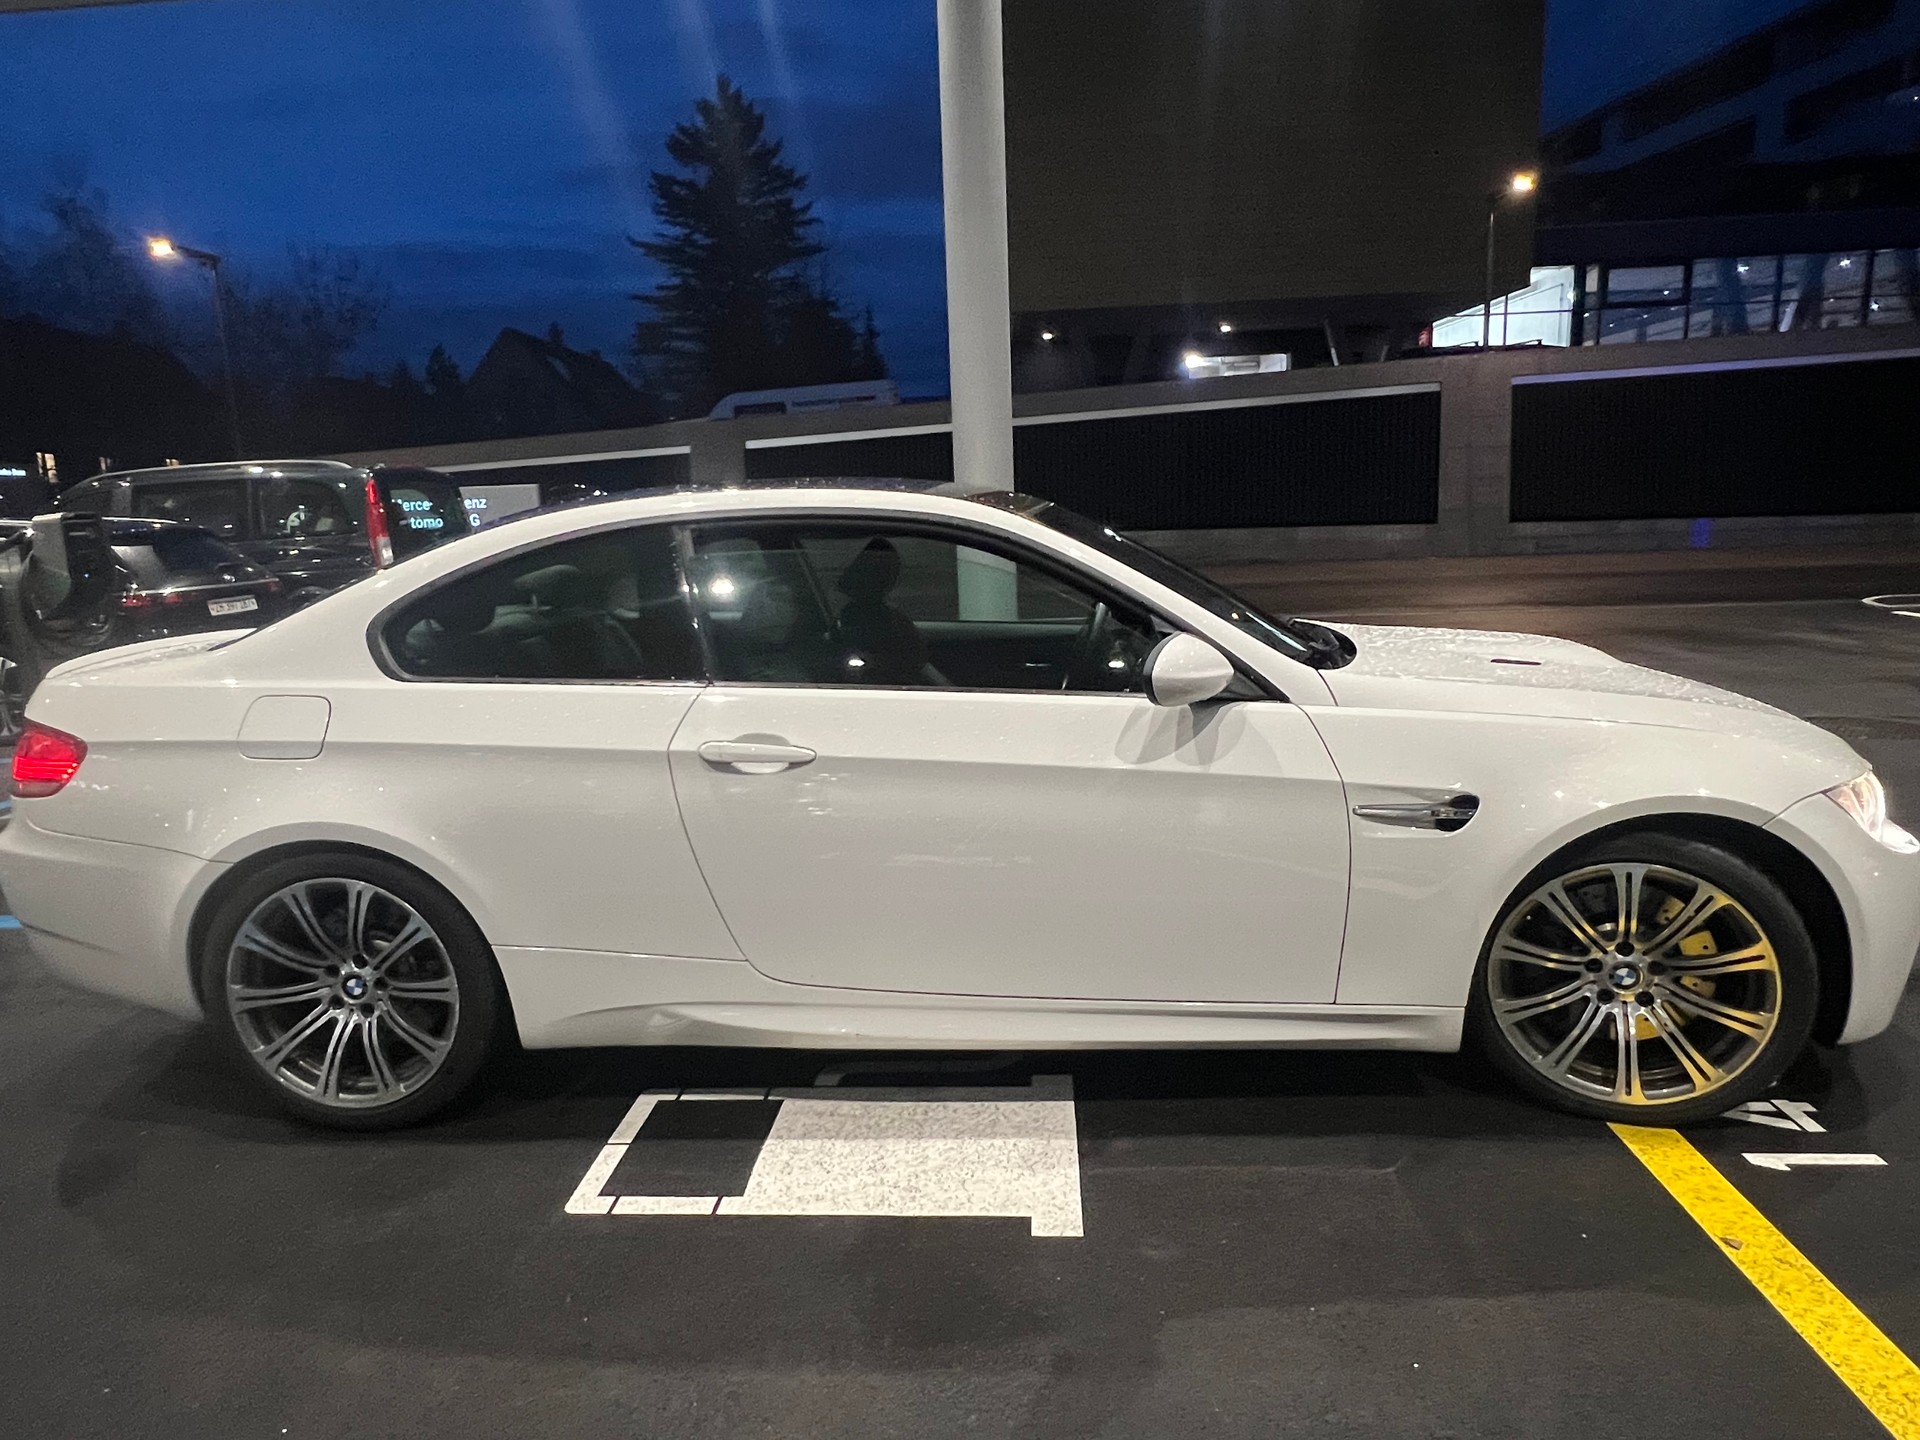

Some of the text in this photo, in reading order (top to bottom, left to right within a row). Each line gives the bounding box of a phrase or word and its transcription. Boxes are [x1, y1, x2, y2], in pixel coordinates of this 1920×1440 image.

[463, 498, 488, 509] enz
[410, 513, 481, 529] tomo G
